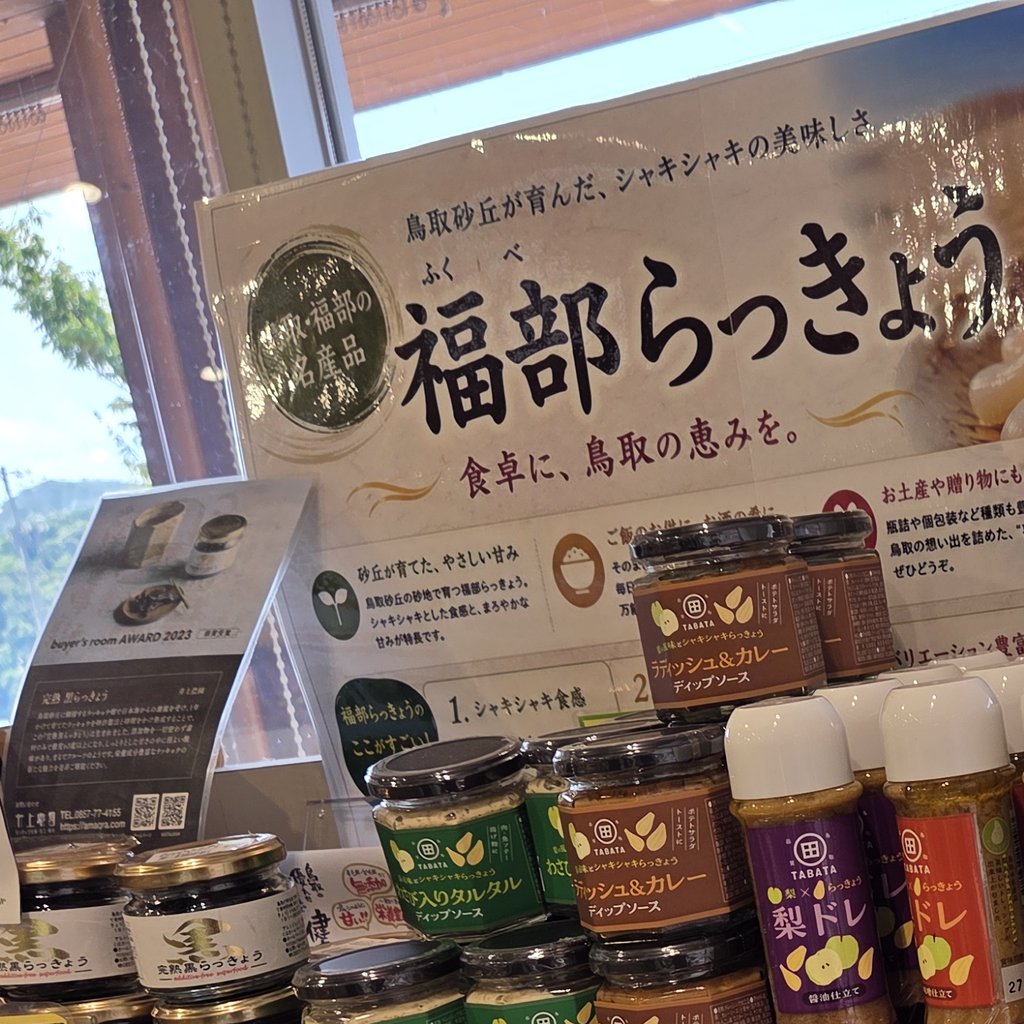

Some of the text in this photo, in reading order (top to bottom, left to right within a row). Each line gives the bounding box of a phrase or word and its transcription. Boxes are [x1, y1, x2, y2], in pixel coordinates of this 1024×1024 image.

[405, 108, 872, 243] 鳥取砂丘が育んだ、シャキシャキの美味しさ
[422, 255, 455, 286] ふく
[394, 186, 1002, 435] 福部らっきょう
[459, 409, 799, 499] 食卓に、鳥取の恵みを。
[356, 544, 520, 584] 砂丘が育てた、やさしい甘み
[892, 560, 957, 579] ぜひどうぞ。
[365, 575, 529, 610] 鳥取砂丘の砂地で育つ福部らっきょう。
[370, 596, 530, 629] シャキシャキとした食感と、まろやかな
[682, 619, 716, 632] TABATA
[118, 634, 162, 645] AWARD
[163, 630, 193, 642] 2023
[673, 671, 751, 694] ディップソース
[340, 699, 425, 726] 福部らっきょうの
[474, 686, 587, 719] シャキシャキ食感
[594, 846, 626, 857] TABATA
[791, 864, 838, 881] TABATA
[416, 907, 484, 922] ディップソース
[588, 900, 662, 918] ディップソース
[771, 899, 867, 941] 梨ドレ
[156, 950, 264, 977] 完熟黒らっきょう
